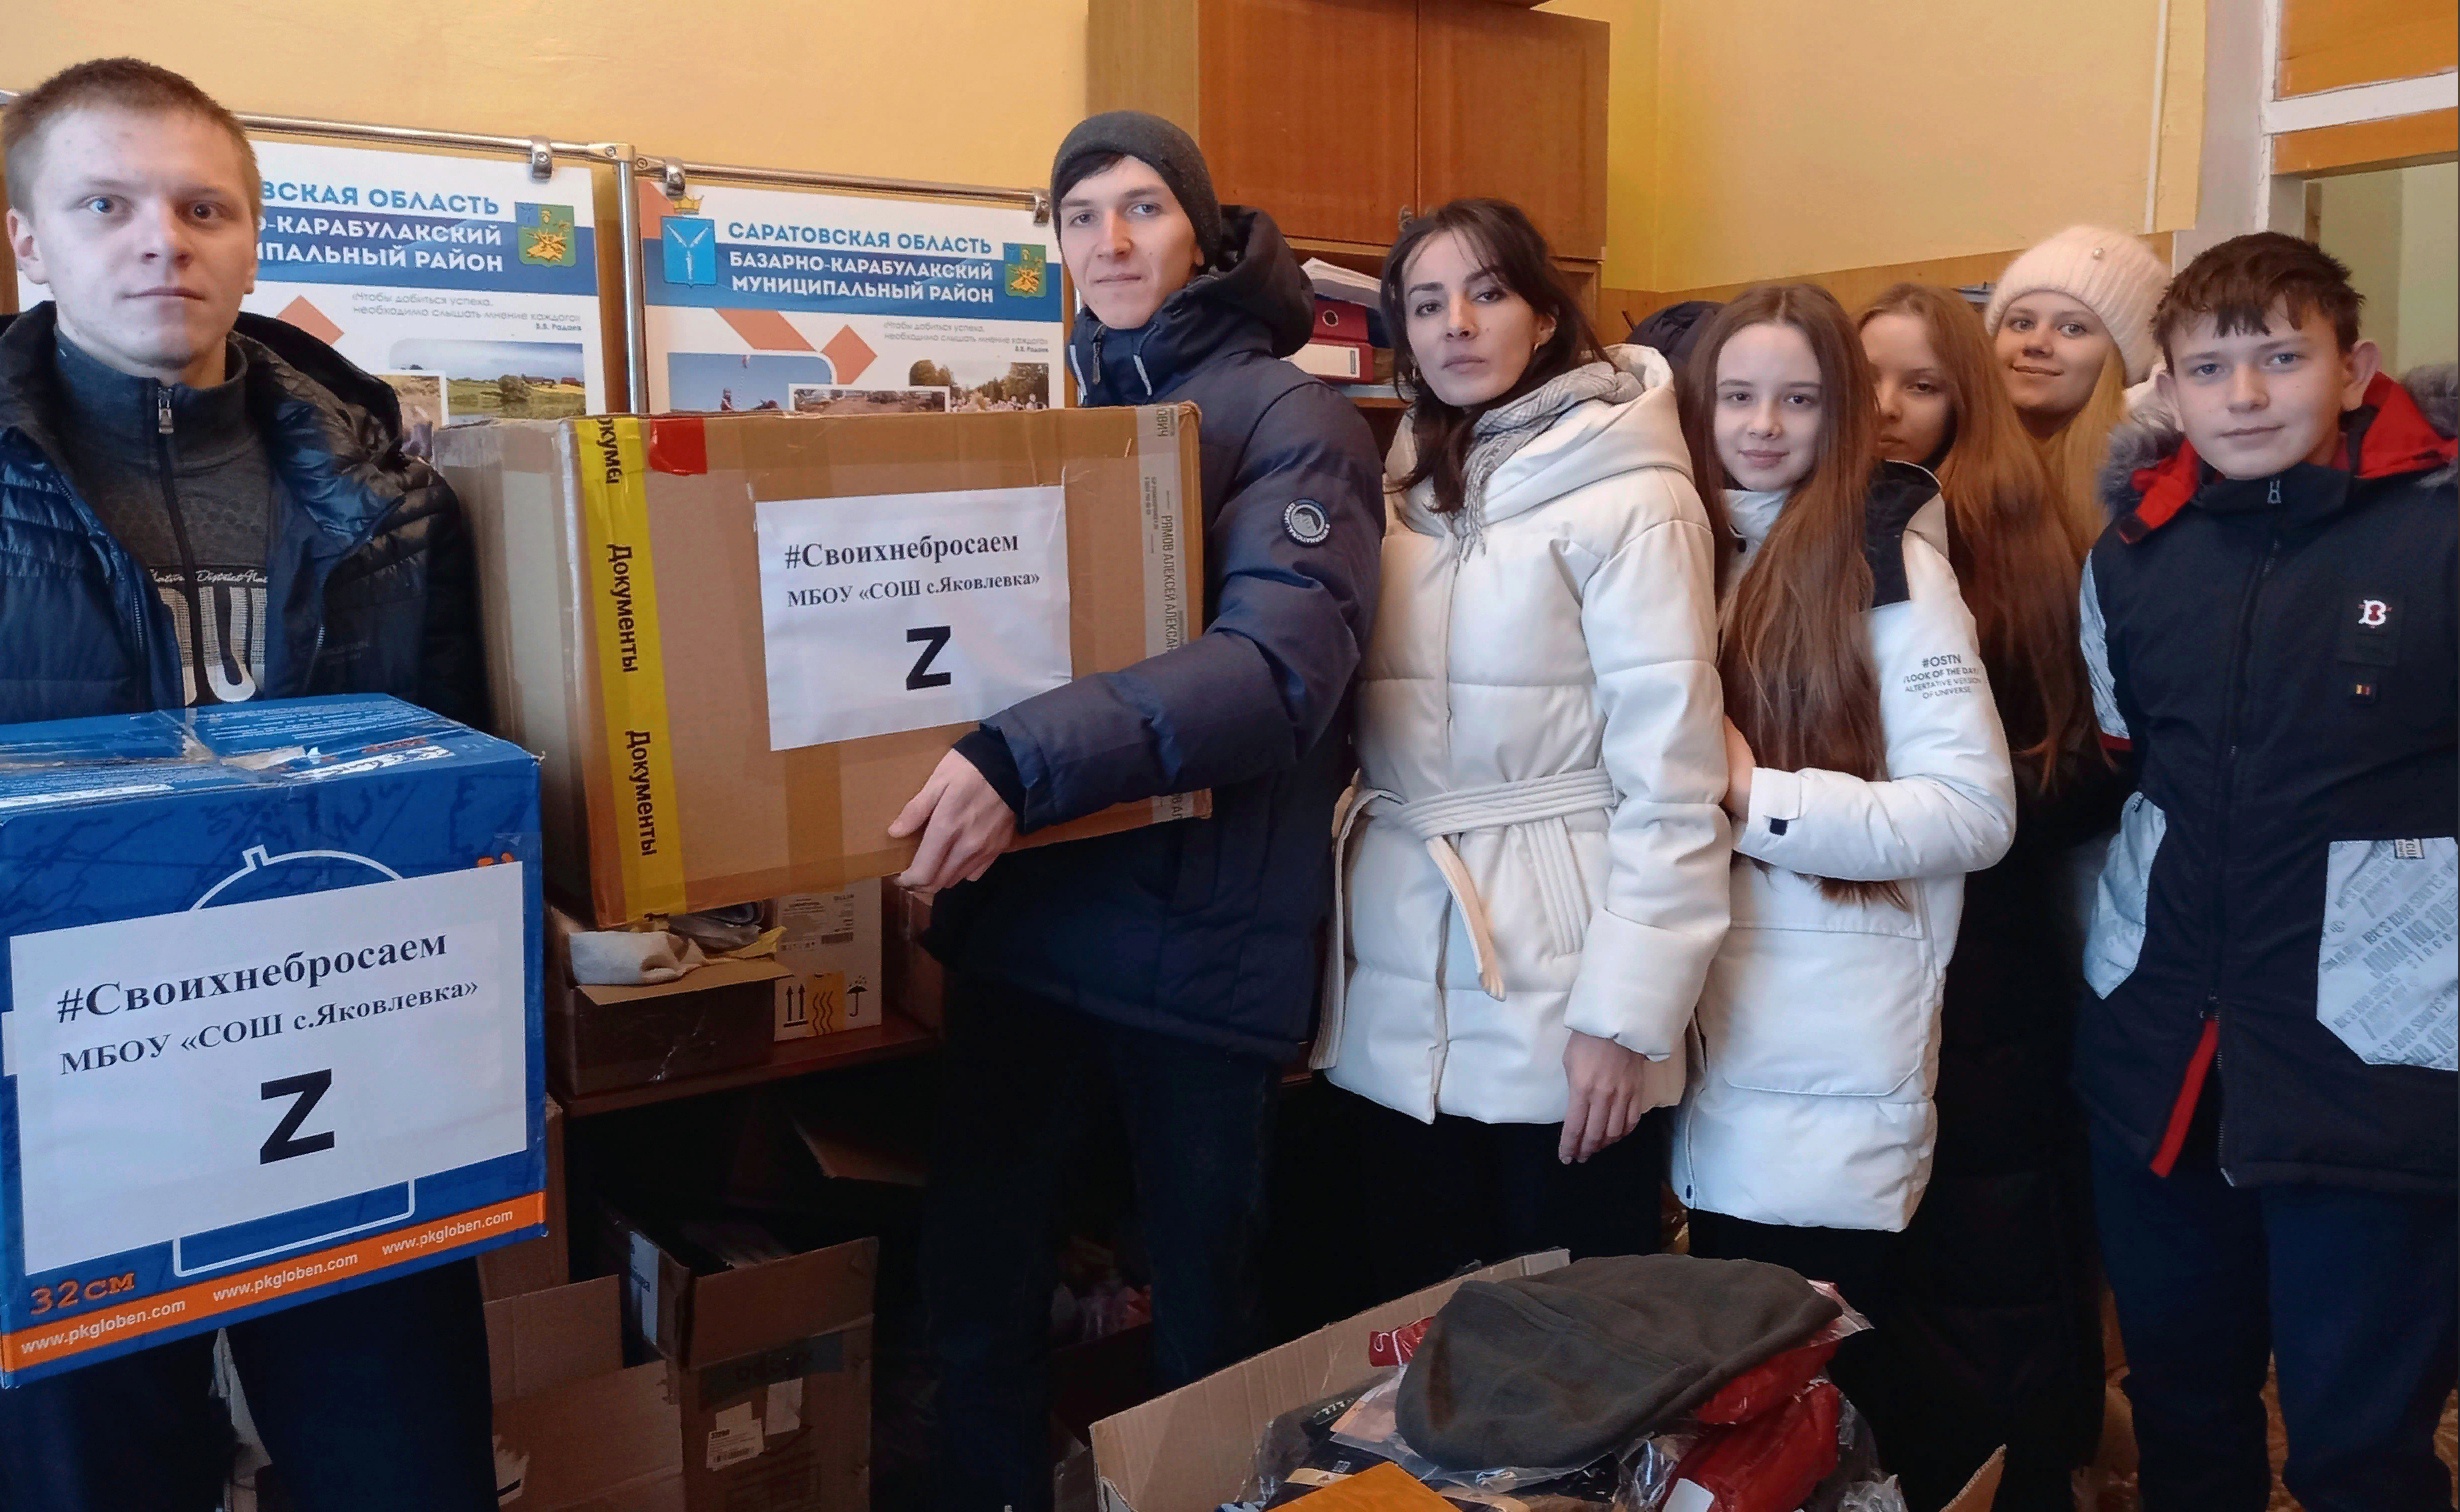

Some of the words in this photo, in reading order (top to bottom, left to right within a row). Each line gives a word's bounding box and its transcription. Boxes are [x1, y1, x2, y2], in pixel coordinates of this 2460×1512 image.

[368, 188, 500, 215] ОБЛАСТЬ
[728, 221, 891, 249] САРАТОВСКАЯ
[896, 232, 992, 255] ОБЛАСТЬ
[414, 248, 504, 272] РАЙОН
[729, 252, 994, 281] БАЗАРНО-КАРАБУЛАКСКИЙ
[731, 275, 924, 301] МУНИЦИПАЛЬНЫЙ
[930, 281, 994, 303] РАЙОН
[785, 532, 1019, 569] #Своихнебросаем
[606, 543, 639, 673] Документы
[787, 585, 853, 608] МБОУ
[858, 579, 921, 602] «СОШ
[926, 571, 1041, 596] с.Яковлевка»
[906, 625, 952, 691] Z
[1922, 653, 1962, 668] #OSTN
[1946, 667, 1961, 676] THE
[625, 730, 657, 856] Документы
[57, 933, 447, 1023] #Своихнебросаем
[60, 1034, 171, 1076] МБОУ
[180, 1012, 285, 1052] «СОШ
[293, 980, 480, 1030] с.Яковлевка»
[260, 1068, 335, 1165] Z
[382, 1209, 514, 1256] www.pkgloben.com
[213, 1252, 359, 1302] www.pkgloben.com
[21, 1300, 186, 1354] www.pkgloben.com
